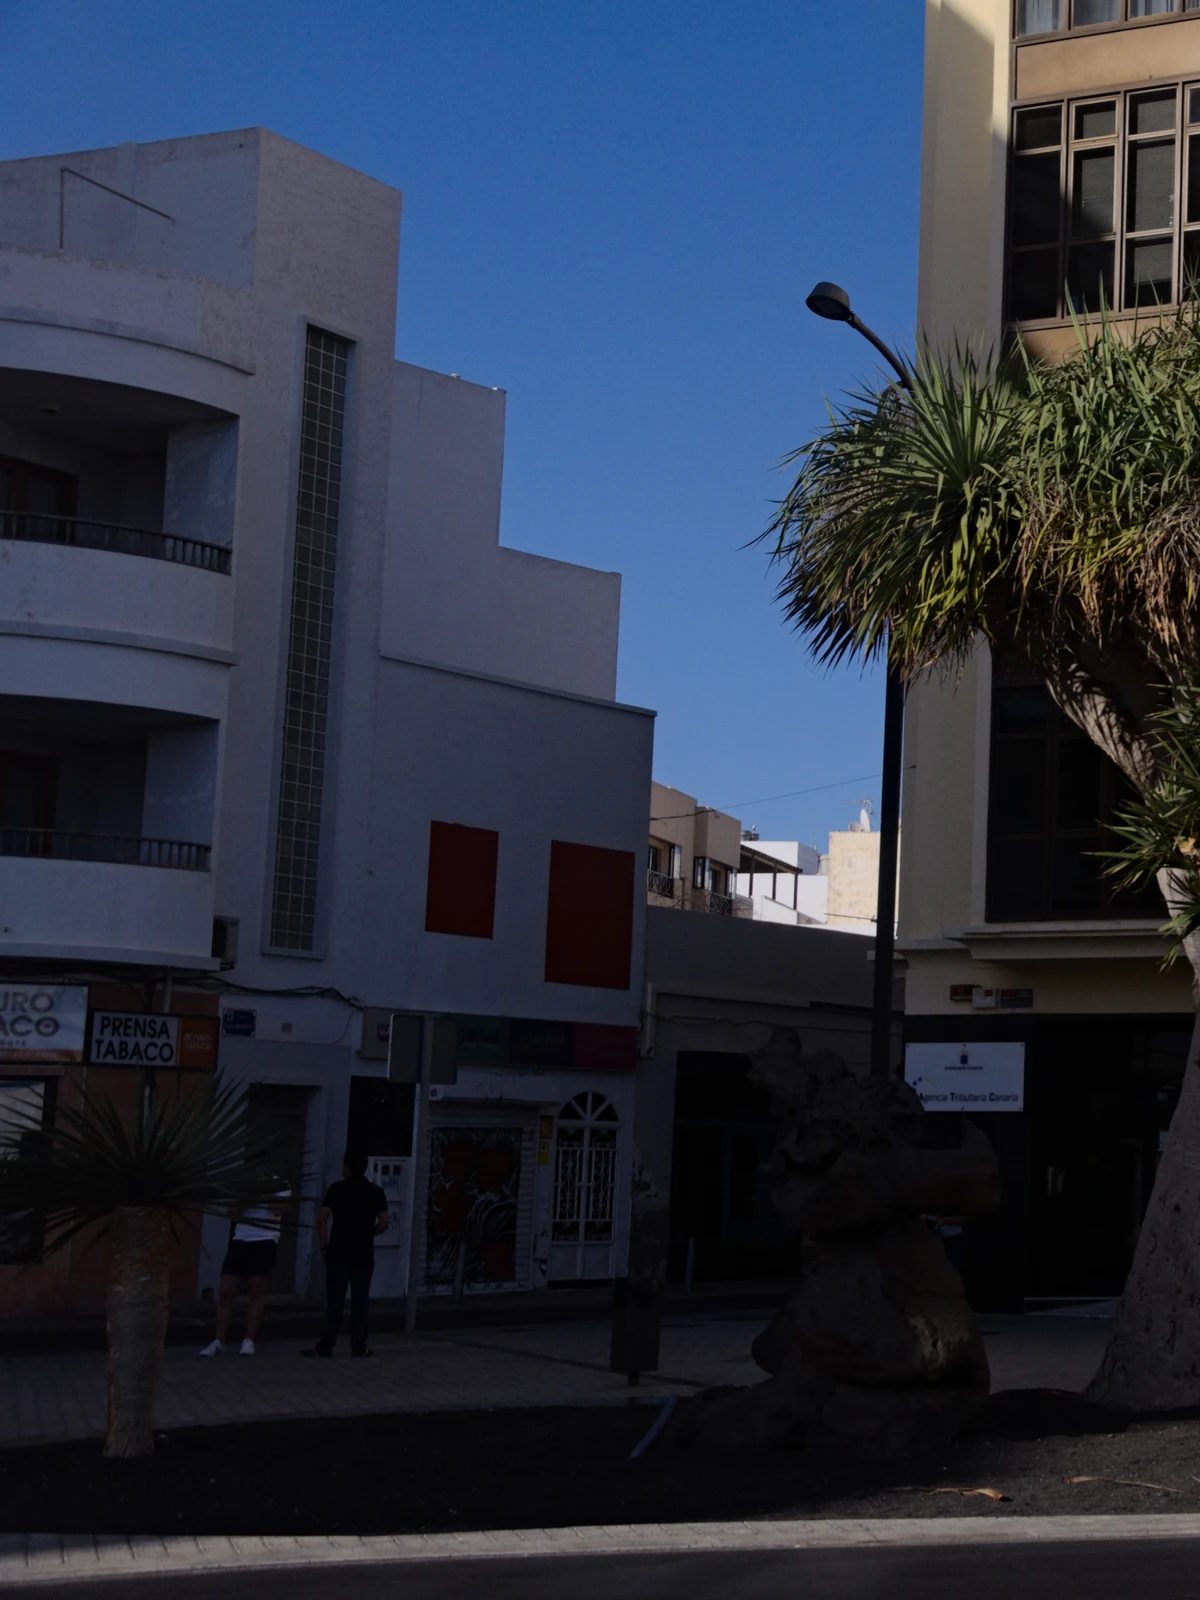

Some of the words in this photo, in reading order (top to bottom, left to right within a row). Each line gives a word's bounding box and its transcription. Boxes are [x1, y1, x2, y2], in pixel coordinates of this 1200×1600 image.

[100, 1016, 170, 1040] PRENSA
[94, 1039, 174, 1062] TABACO
[920, 1092, 948, 1103] Agencia
[950, 1092, 987, 1102] Tributaria
[989, 1092, 1019, 1102] Canaria
